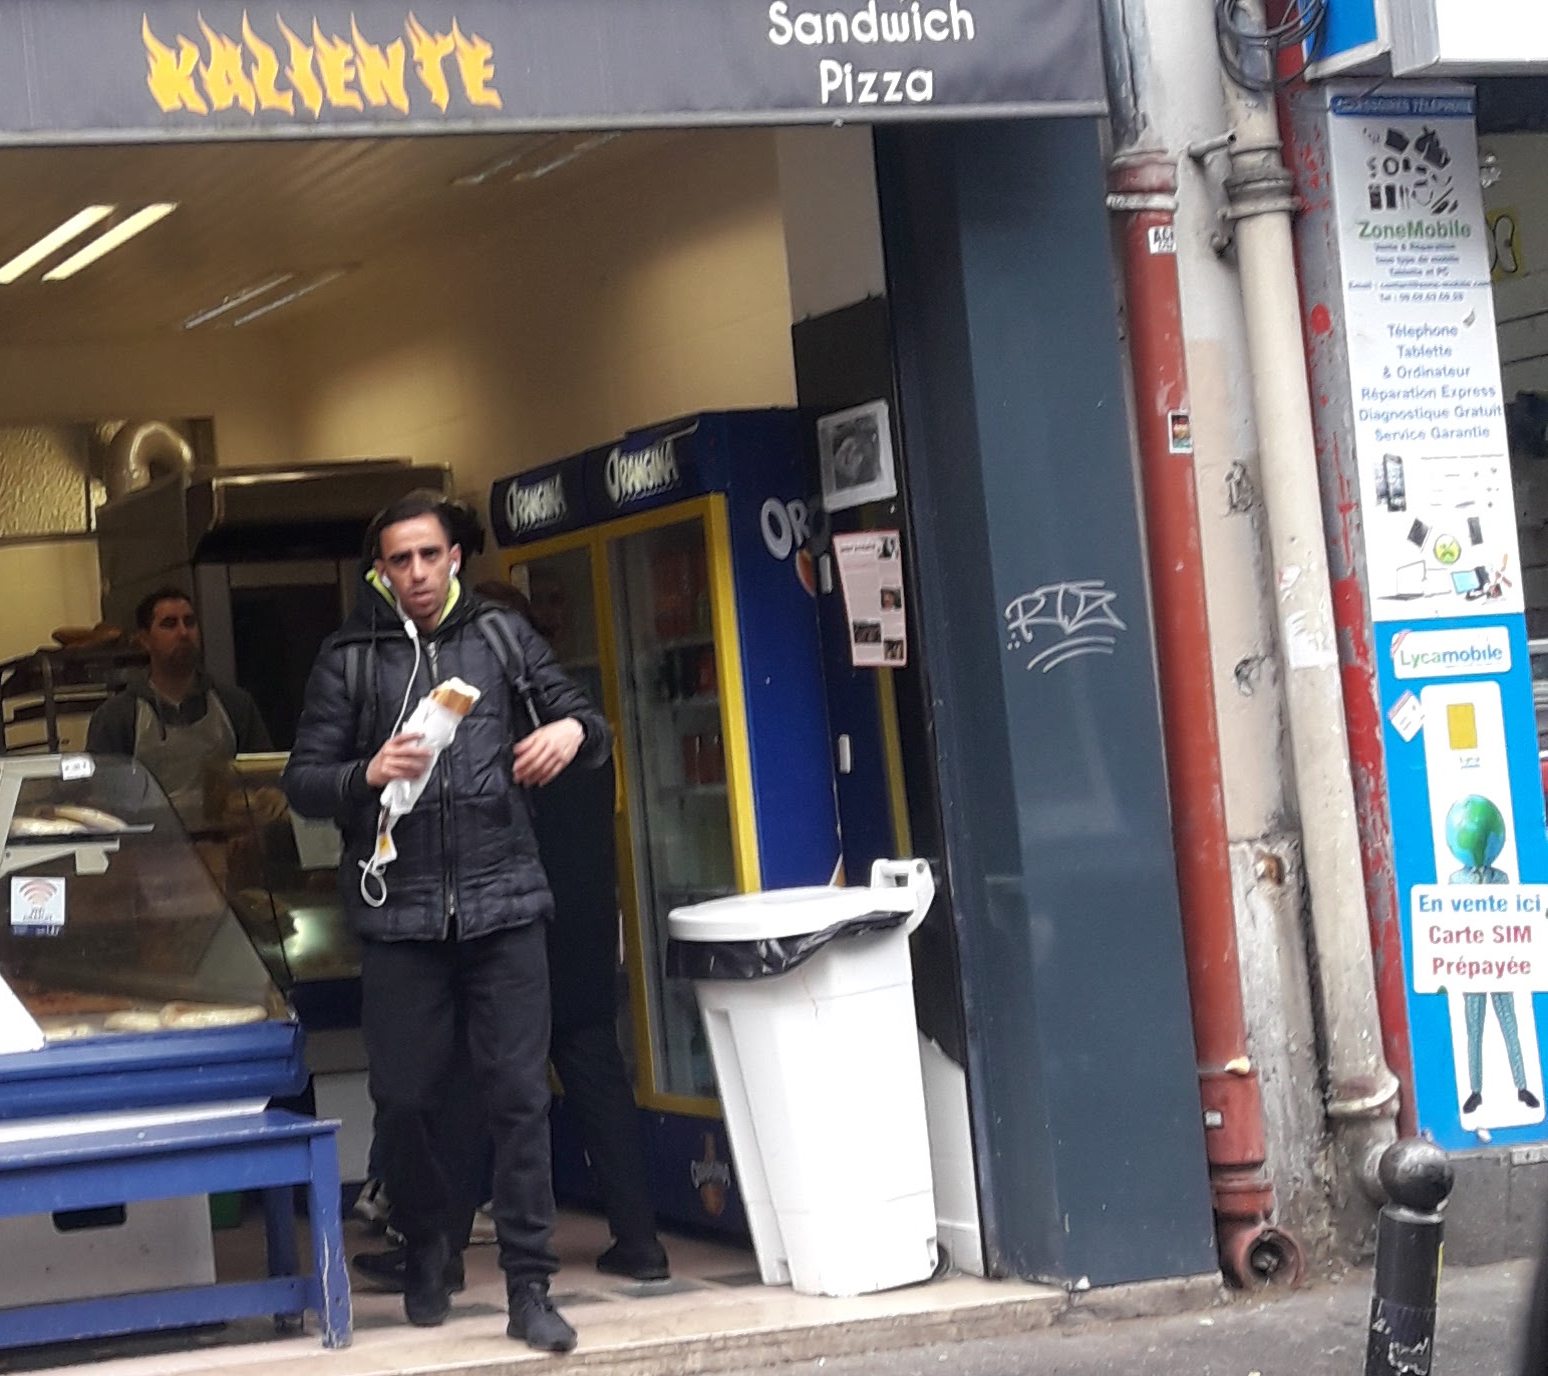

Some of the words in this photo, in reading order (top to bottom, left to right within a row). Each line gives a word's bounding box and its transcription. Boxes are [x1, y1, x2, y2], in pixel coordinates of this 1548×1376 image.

[142, 8, 502, 120] KALIENTE
[819, 59, 933, 104] Pizza
[1355, 220, 1472, 239] ZoneMobile
[1396, 344, 1453, 359] Tablette
[1396, 363, 1471, 379] Ordinateur
[1361, 385, 1437, 403] Réparation
[1441, 384, 1497, 400] Express
[1358, 406, 1450, 424] Diagnostique
[1454, 403, 1503, 419] Gratuit
[1374, 427, 1426, 442] Service
[1430, 425, 1491, 440] Garantie
[1400, 644, 1503, 669] Lycamobile
[1419, 893, 1444, 913] En
[1450, 894, 1508, 913] vente
[1516, 893, 1541, 913] ici
[1428, 925, 1485, 944] Carte
[1492, 925, 1532, 944] SIM
[1432, 955, 1532, 979] Prépayée
